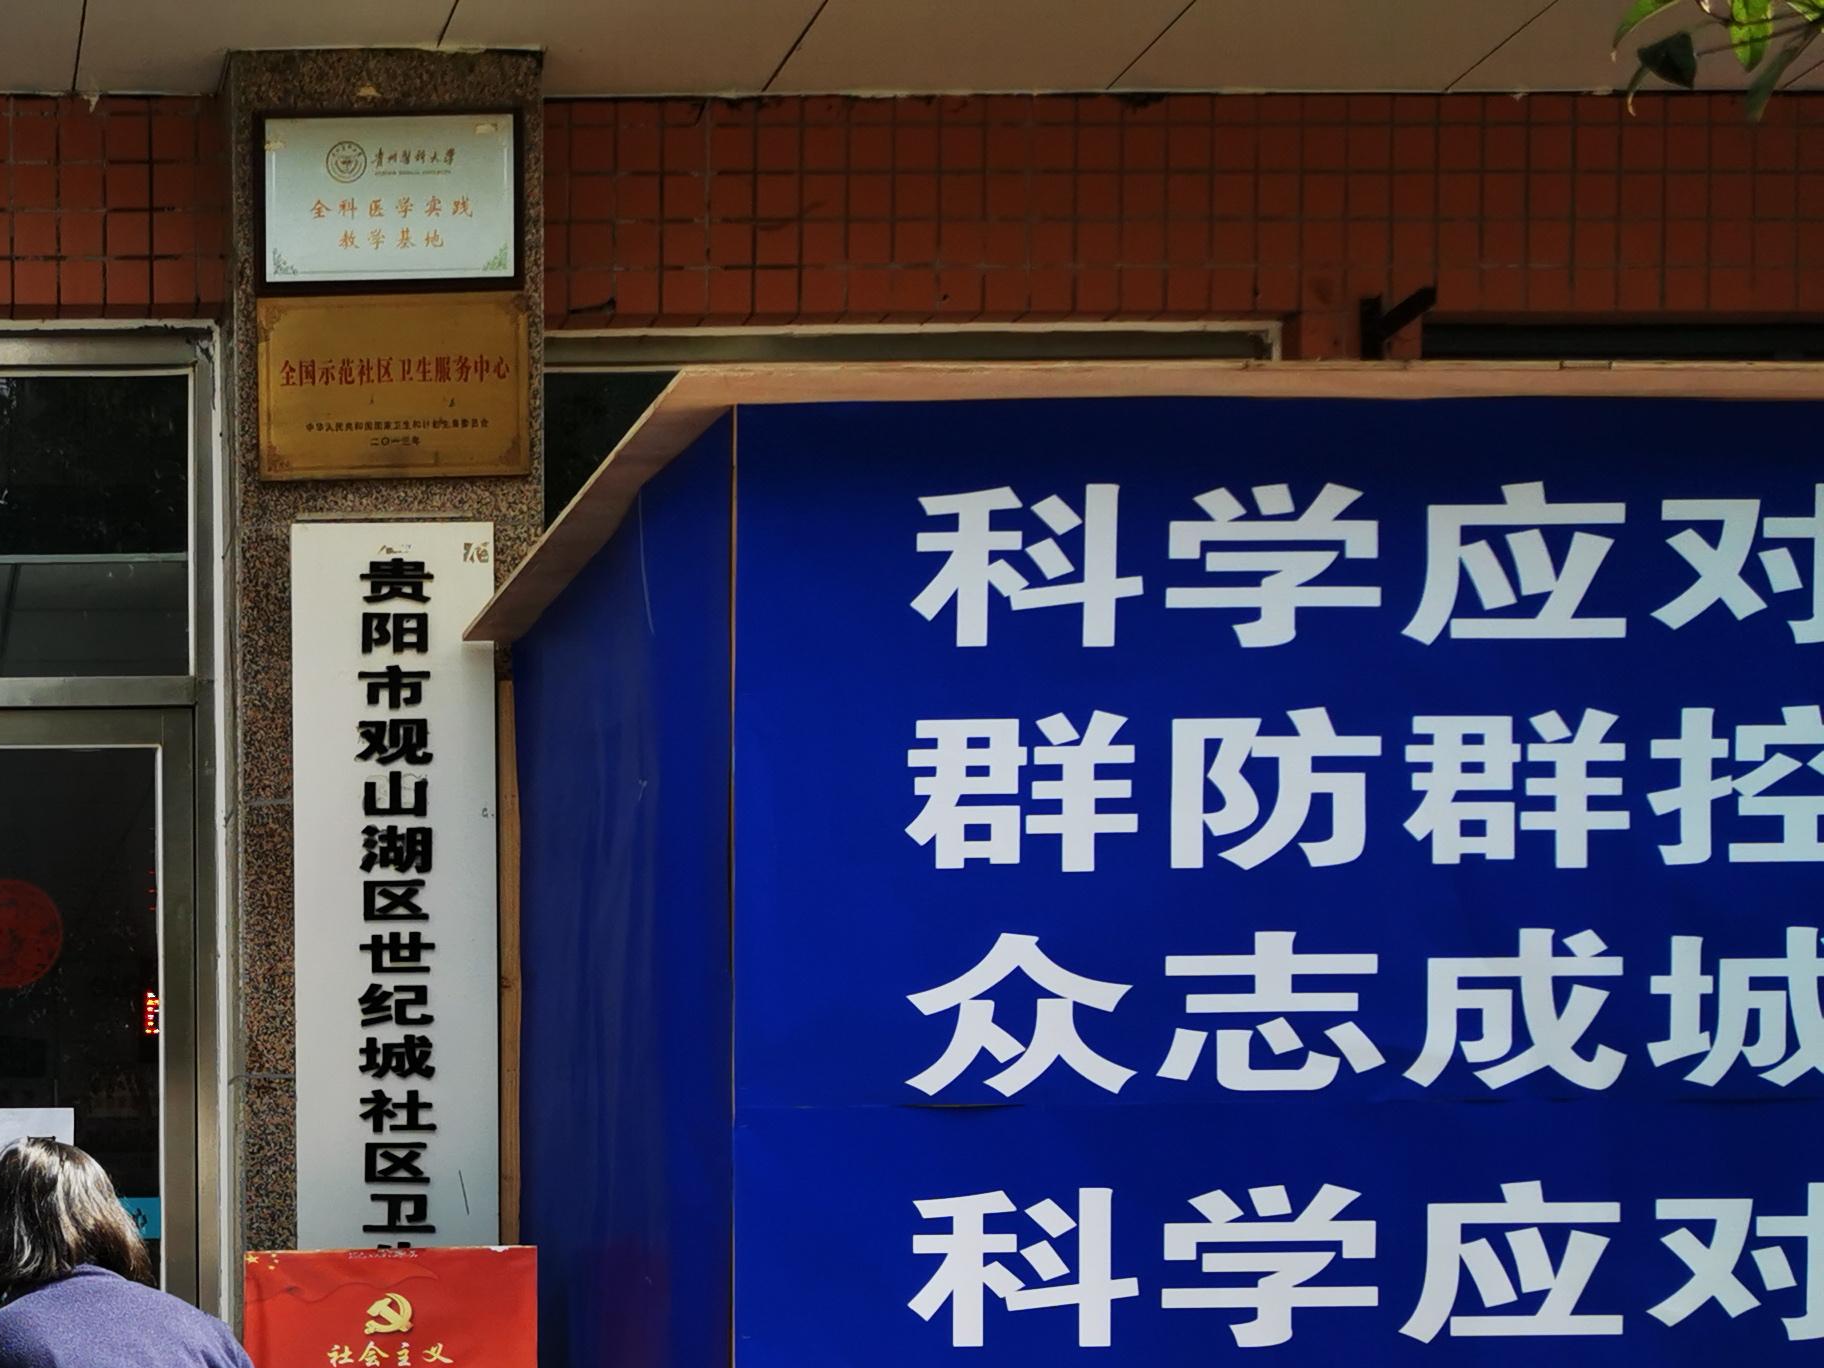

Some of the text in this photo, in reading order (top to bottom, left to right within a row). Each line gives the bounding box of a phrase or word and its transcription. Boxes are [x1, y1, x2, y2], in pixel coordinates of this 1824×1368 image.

[310, 197, 474, 220] 全科医学实践
[338, 228, 444, 250] 教学基地
[280, 355, 510, 388] 全国示范社区卫生服务中心
[909, 481, 1824, 648] 科学应对
[904, 705, 1824, 872] 群防群控
[356, 556, 437, 1248] 贵阳市观山湖区世纪城社区卫
[905, 927, 1824, 1097] 众志成城
[908, 1180, 1824, 1347] 科学应对
[326, 1341, 454, 1368] 社会主义
